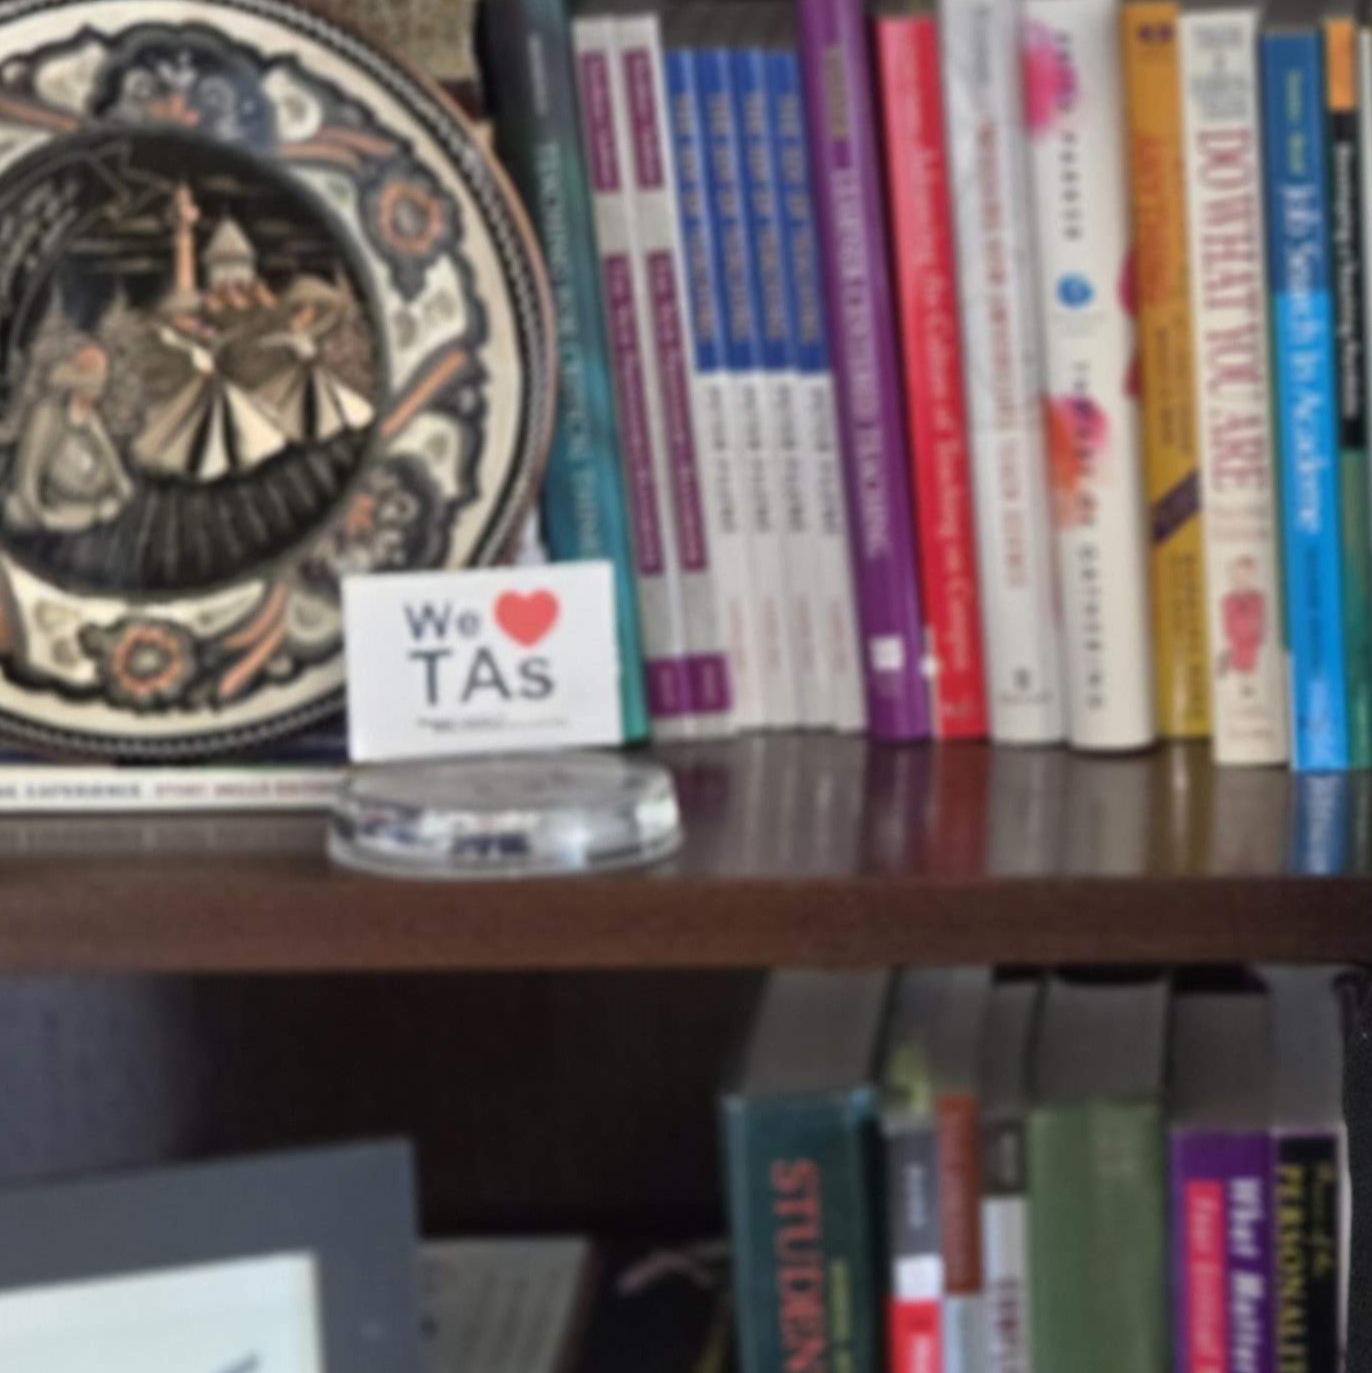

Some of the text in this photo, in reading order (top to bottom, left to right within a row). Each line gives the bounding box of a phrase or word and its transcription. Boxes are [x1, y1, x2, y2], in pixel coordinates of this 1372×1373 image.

[1195, 128, 1251, 192] DO
[1333, 143, 1354, 244] Developing
[1276, 184, 1322, 236] Job
[1199, 195, 1257, 312] WHAT
[1286, 241, 1327, 346] Search
[1335, 262, 1358, 337] Teaching
[1203, 324, 1264, 392] YOU
[1209, 412, 1269, 493] ARE
[1291, 391, 1328, 535] Academe
[404, 599, 483, 641] We
[407, 646, 557, 709] TAs
[1229, 1177, 1264, 1262] What
